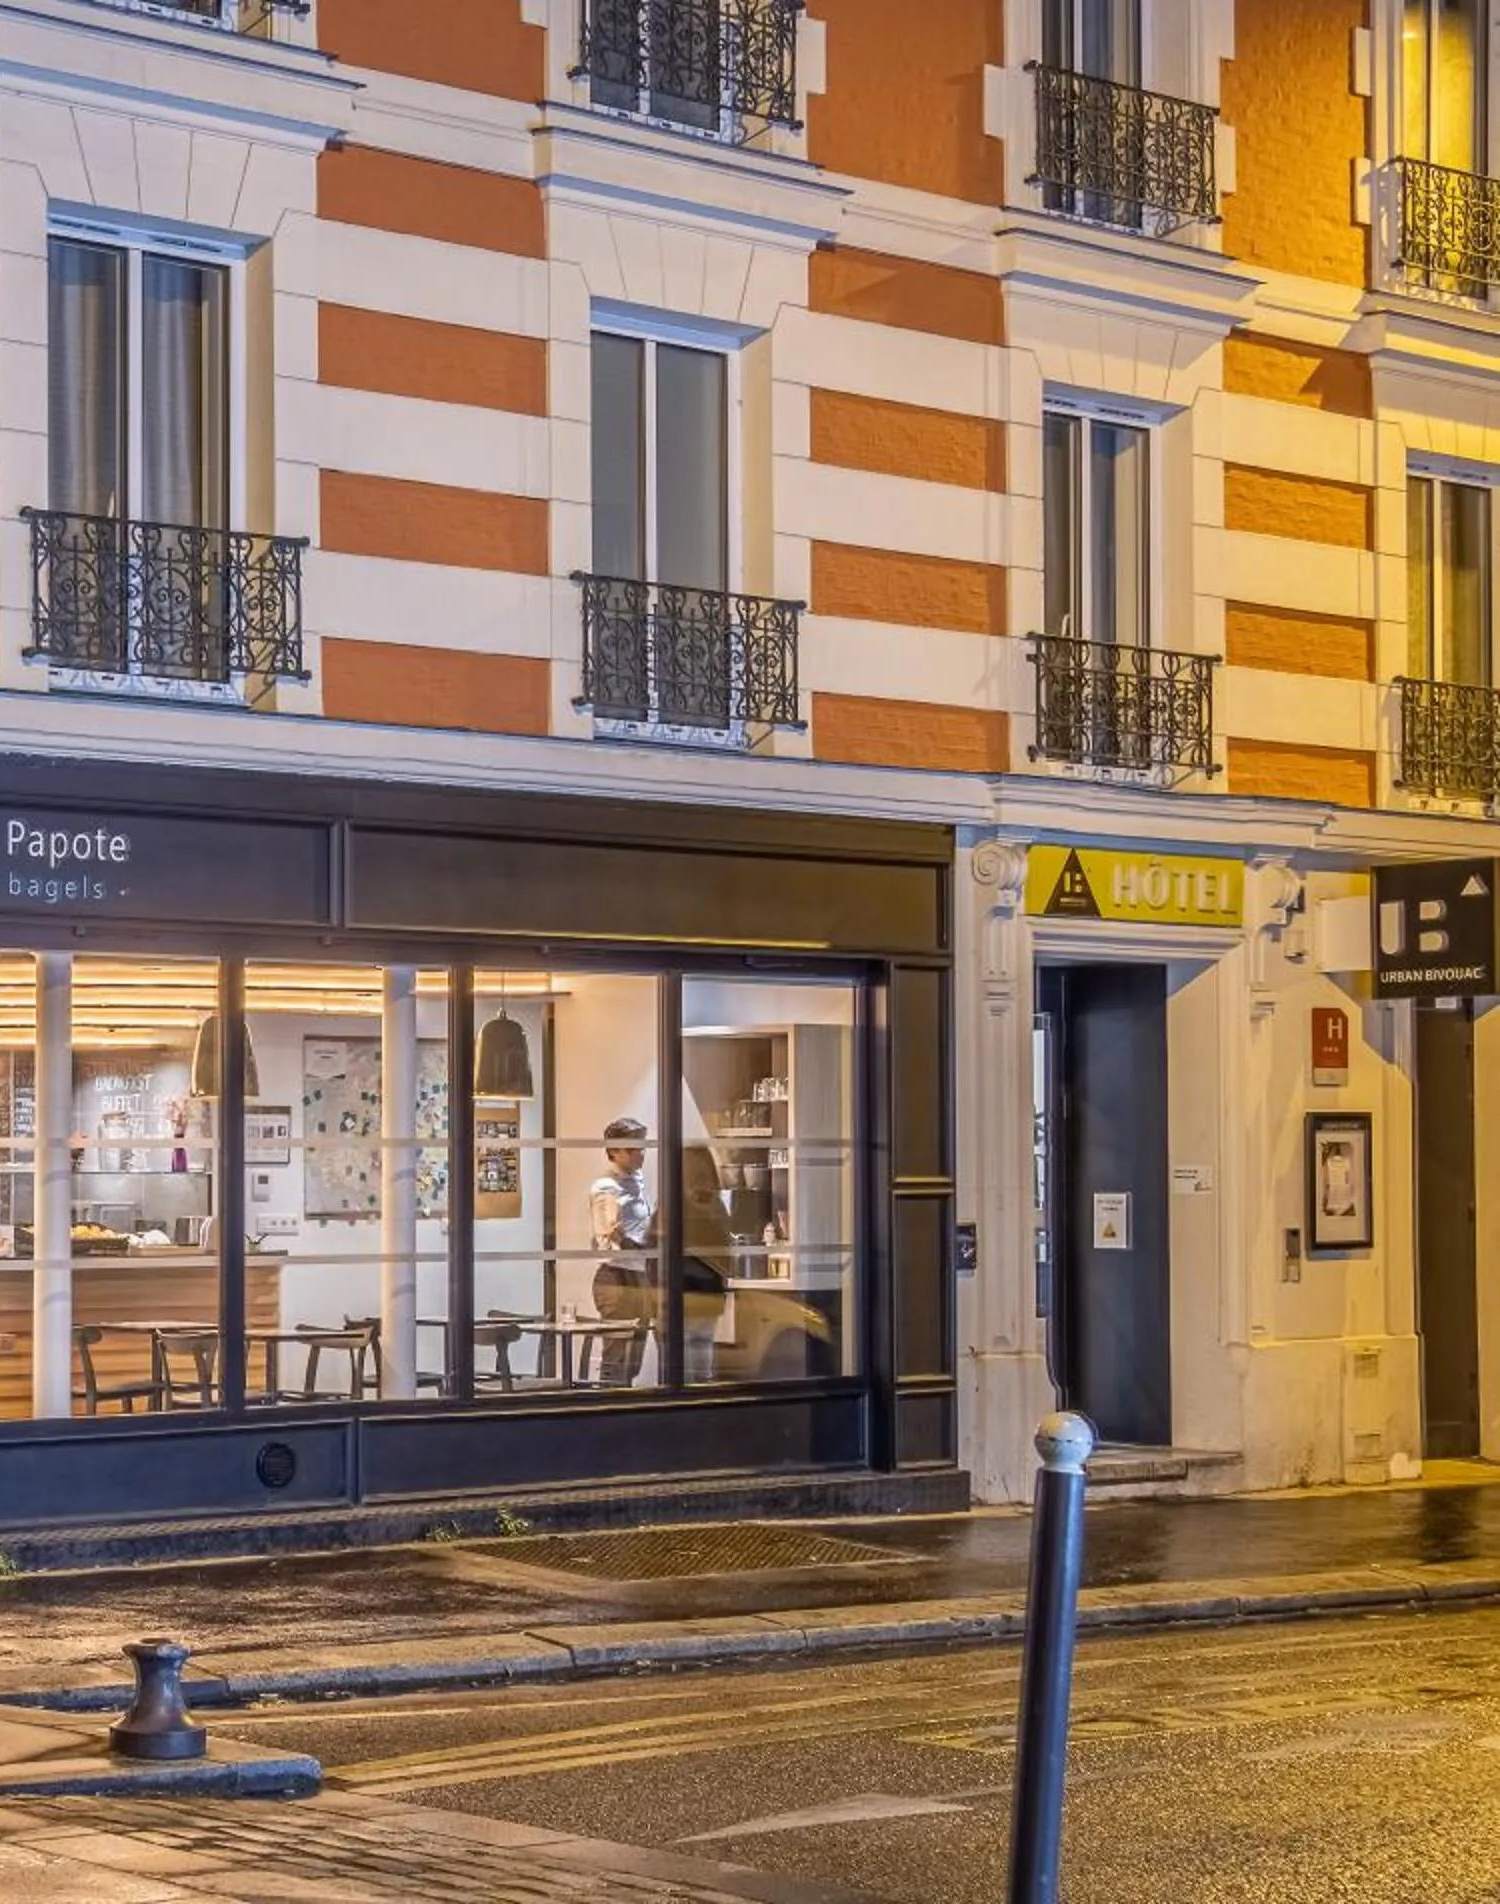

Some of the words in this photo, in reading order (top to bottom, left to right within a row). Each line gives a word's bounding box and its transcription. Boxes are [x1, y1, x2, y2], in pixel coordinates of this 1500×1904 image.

[7, 820, 128, 868] Papote
[8, 872, 104, 903] bagels
[1112, 858, 1238, 915] HÔTEL
[1380, 969, 1422, 984] URBAN
[1425, 967, 1483, 982] BIVOUAC
[1327, 1017, 1343, 1040] H
